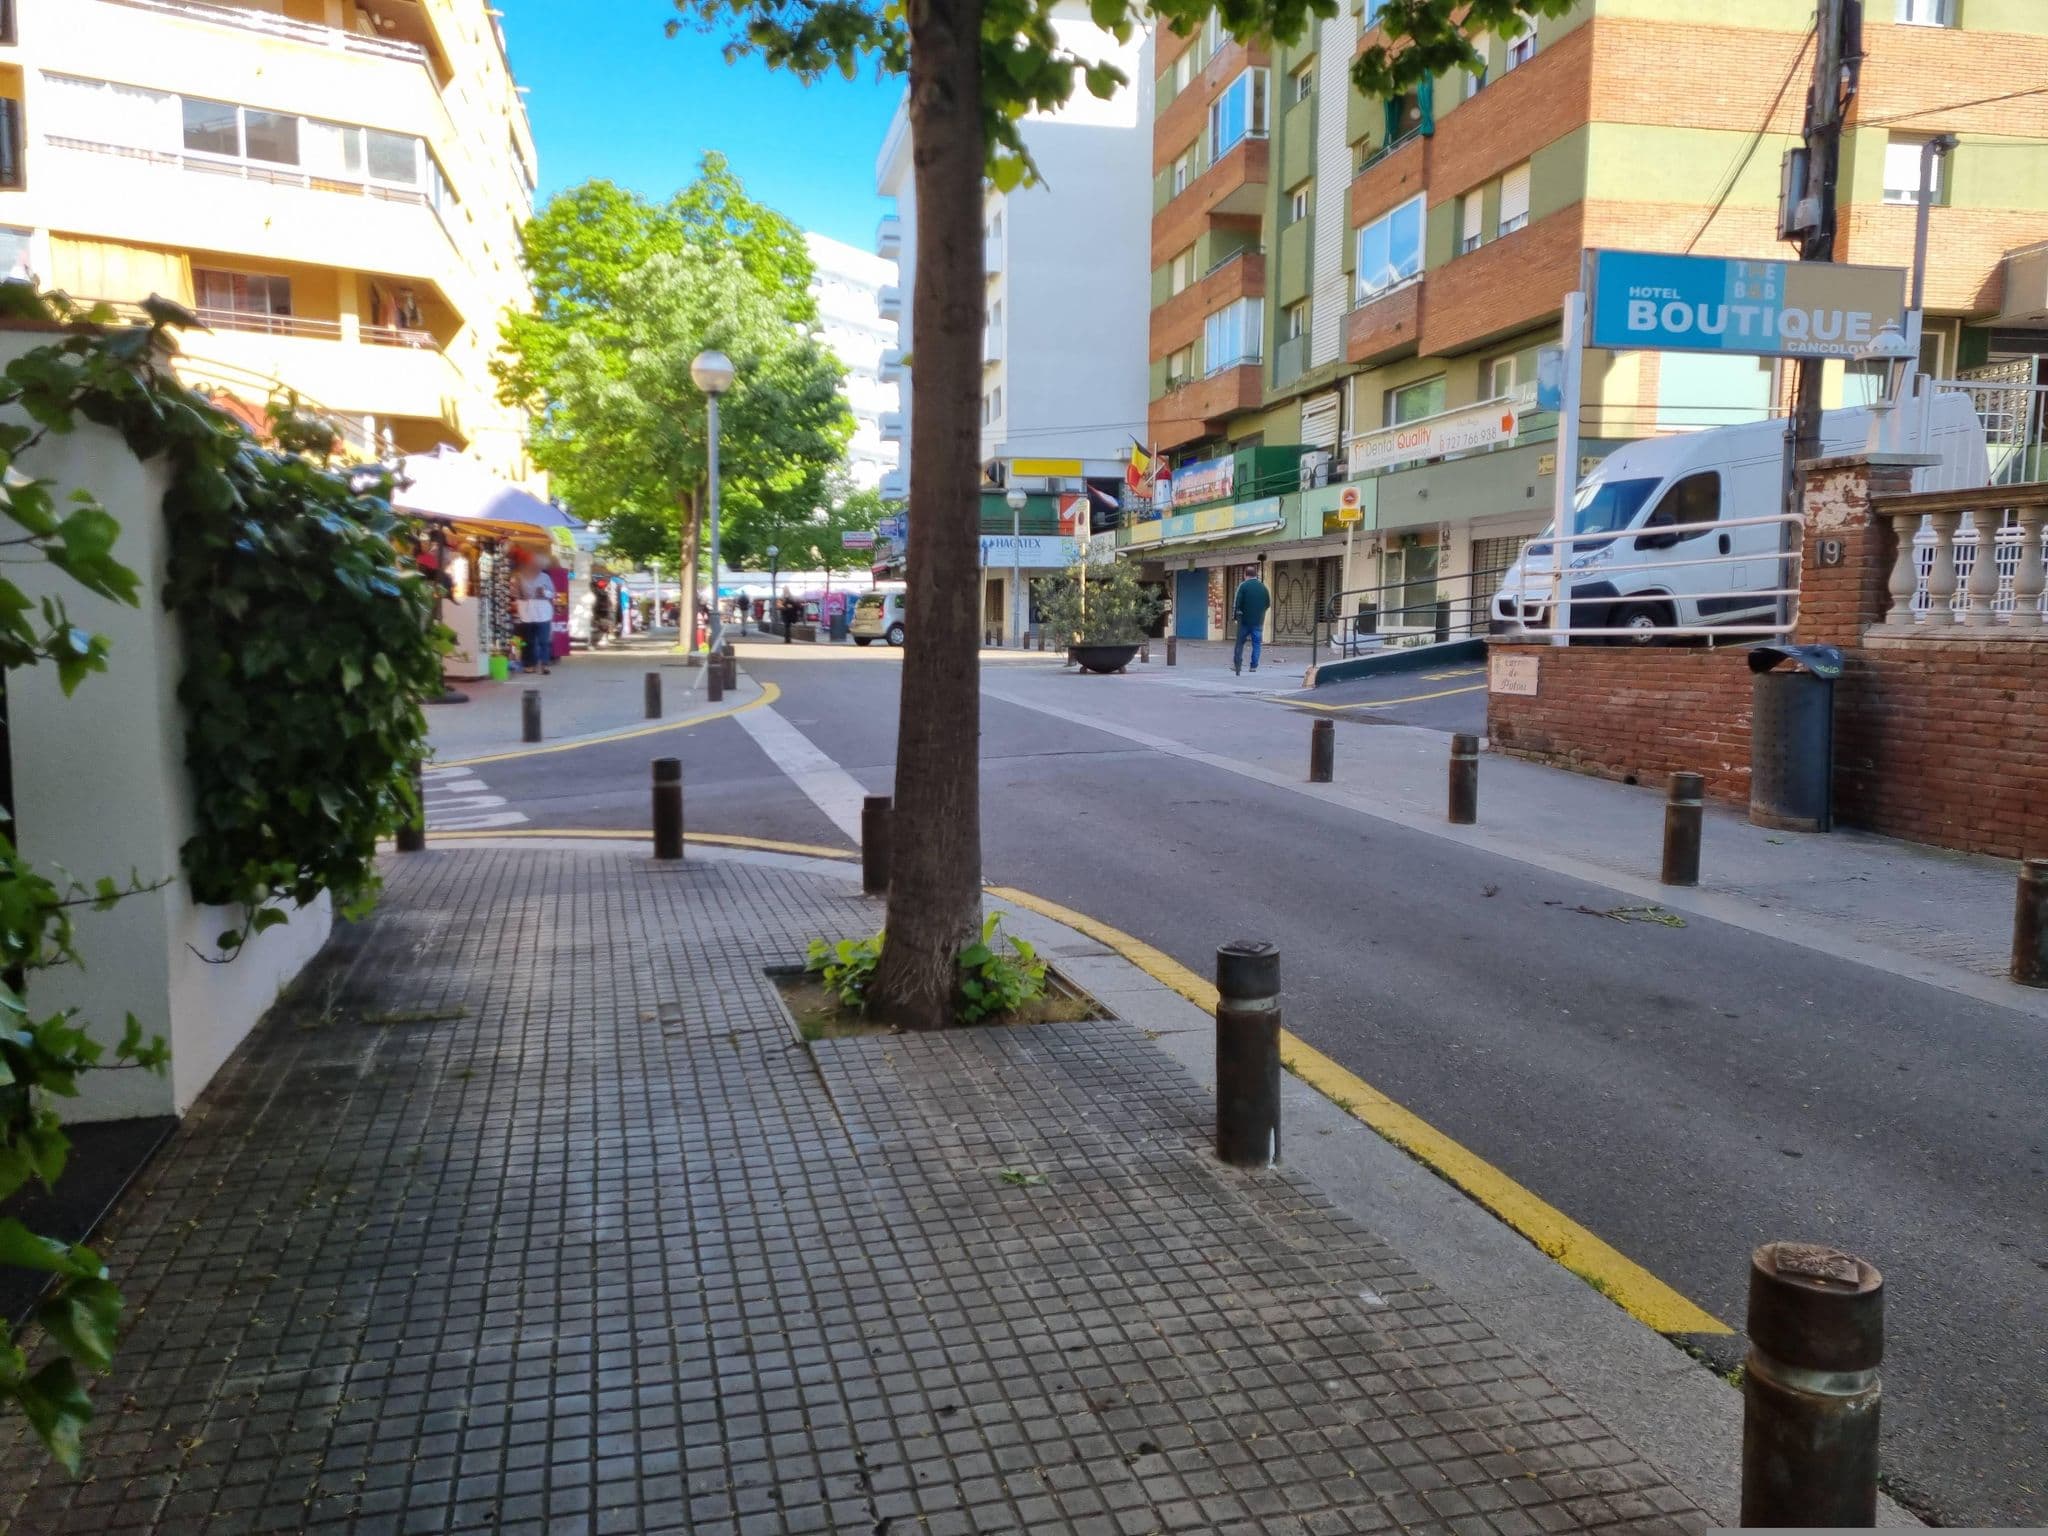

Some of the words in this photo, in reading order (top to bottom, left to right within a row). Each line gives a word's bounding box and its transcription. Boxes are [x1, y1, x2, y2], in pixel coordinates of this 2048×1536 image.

[1629, 286, 1681, 300] HOTEL
[1628, 300, 1873, 343] BOUTIQUE
[1397, 425, 1432, 449] Quality
[1816, 540, 1840, 566] 19
